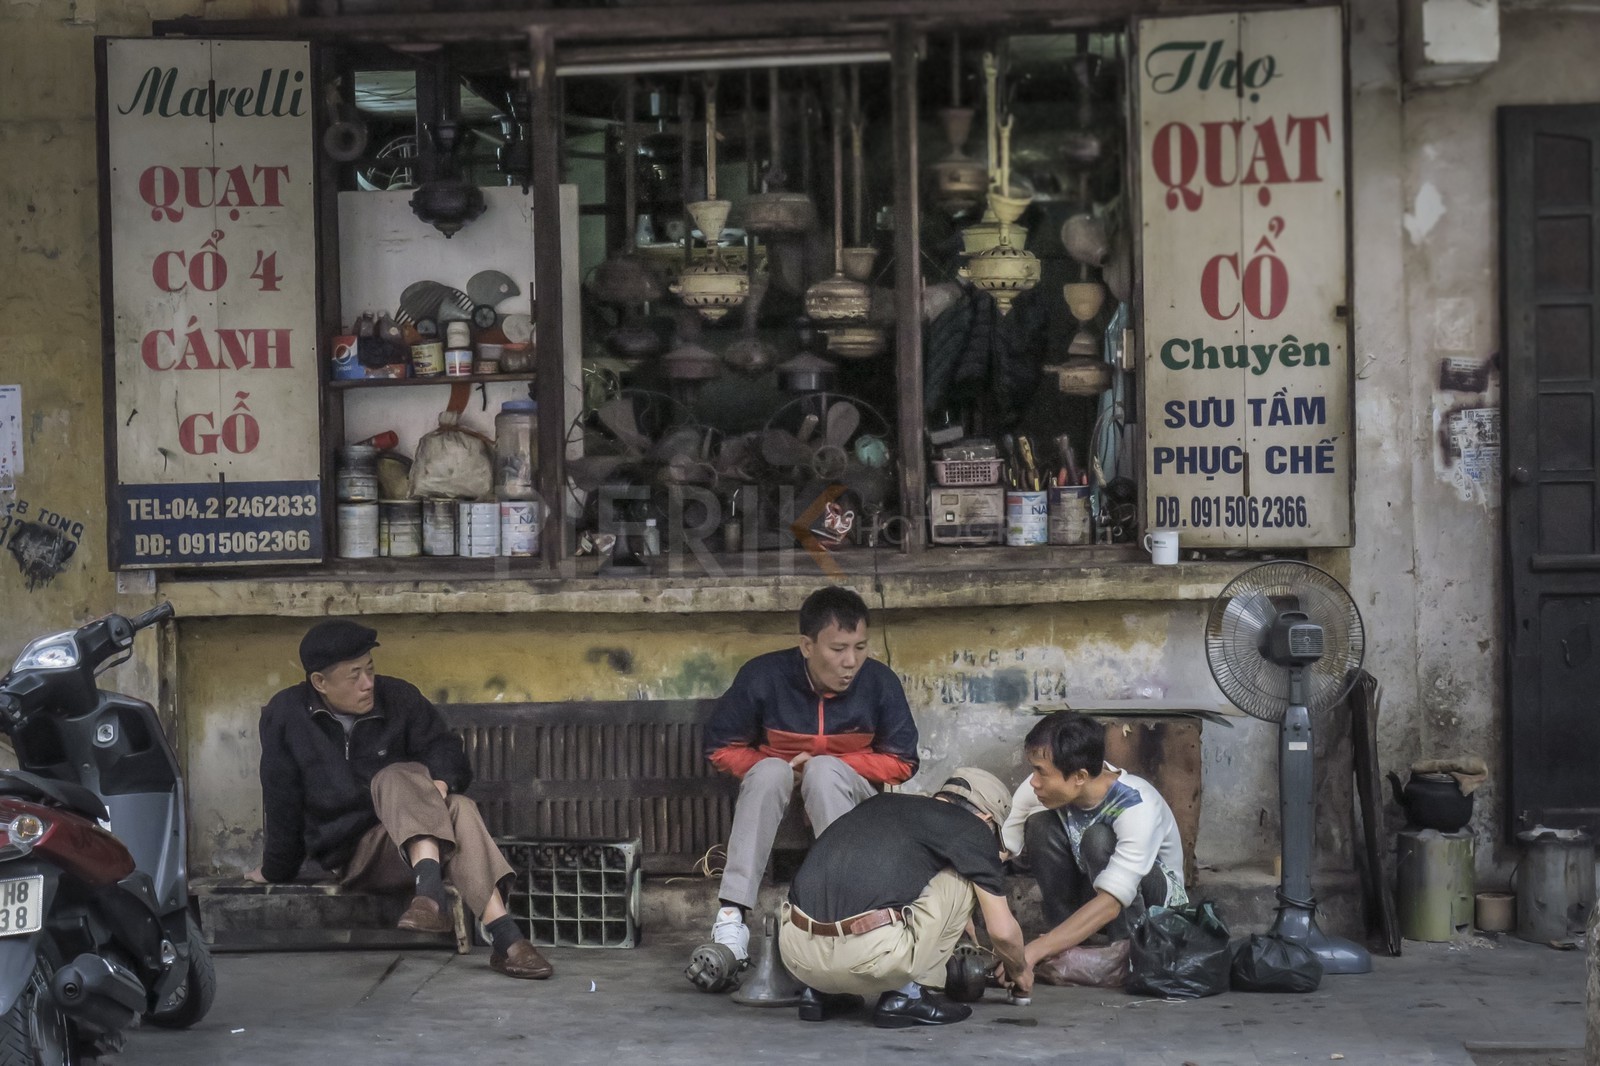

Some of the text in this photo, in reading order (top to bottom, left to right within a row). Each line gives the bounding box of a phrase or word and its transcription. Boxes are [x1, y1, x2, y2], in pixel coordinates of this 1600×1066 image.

[117, 66, 307, 118] Marelli
[1145, 40, 1283, 103] Thọ
[1152, 113, 1331, 212] QUẠT
[138, 164, 290, 222] QUẠT
[152, 229, 284, 292] CỔ 4
[1200, 215, 1289, 320] CỔ
[141, 315, 295, 371] CÁNH
[1160, 334, 1331, 375] Chuyên
[178, 391, 260, 455] GỖ
[1164, 387, 1326, 429] SƯU TẦM
[1153, 436, 1339, 481] PHỤC CHẾ
[178, 530, 310, 554] 0915062366
